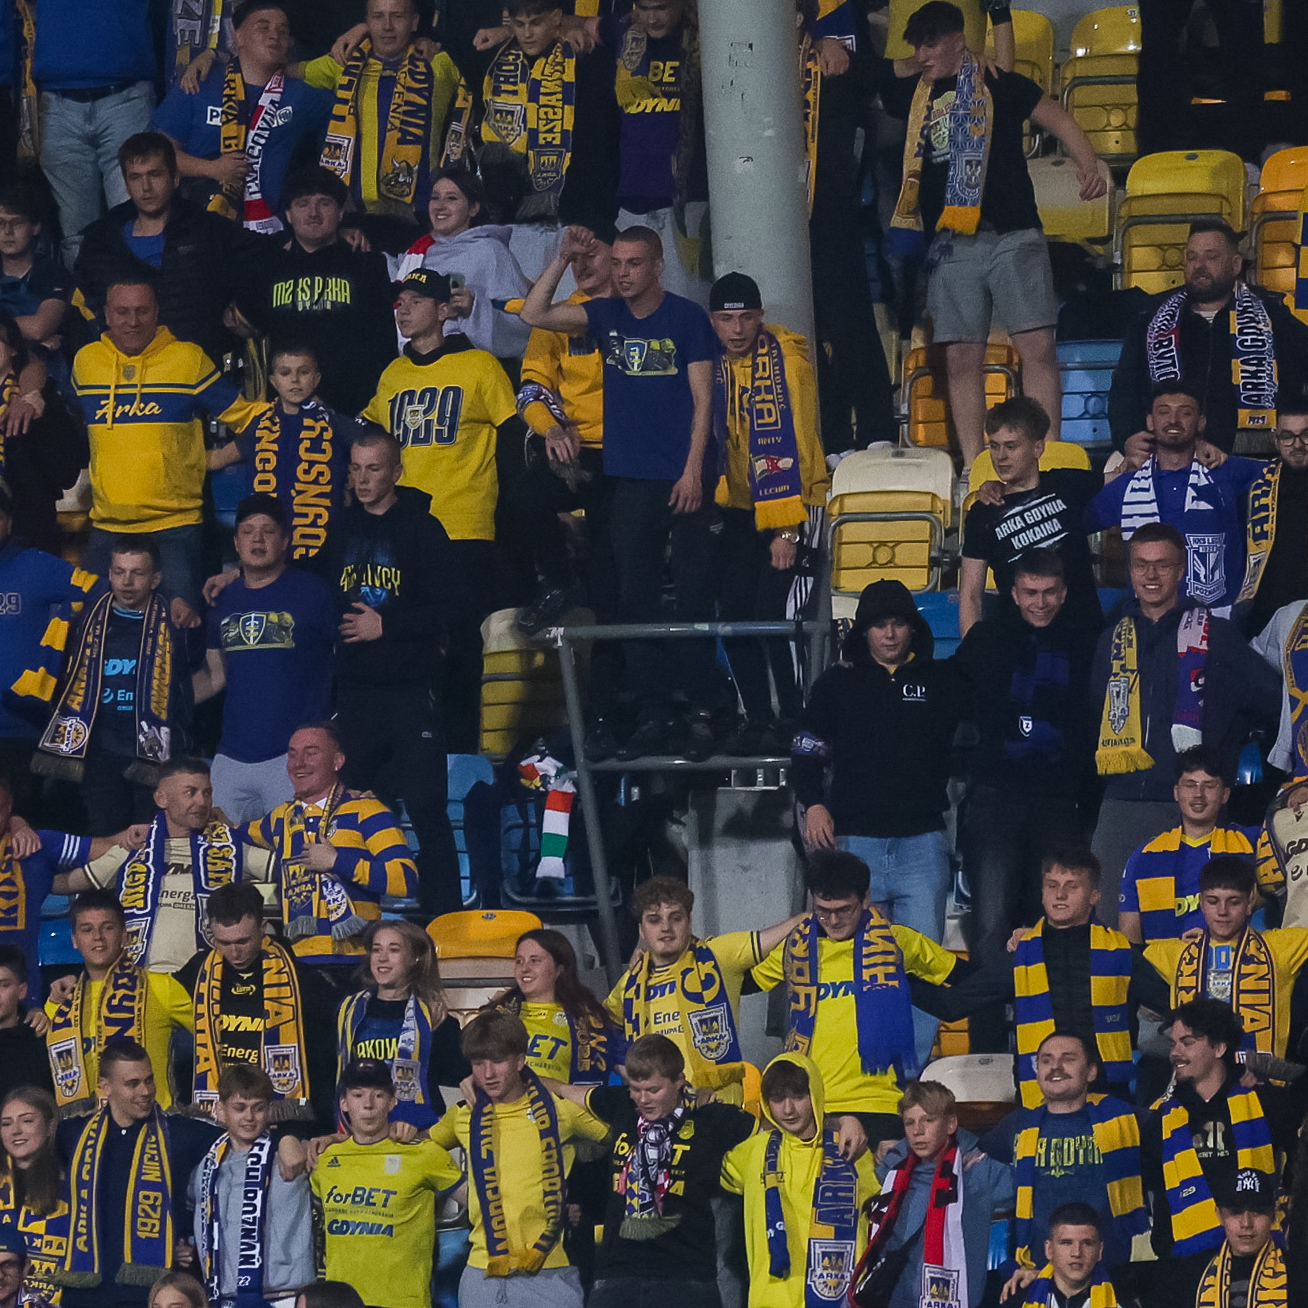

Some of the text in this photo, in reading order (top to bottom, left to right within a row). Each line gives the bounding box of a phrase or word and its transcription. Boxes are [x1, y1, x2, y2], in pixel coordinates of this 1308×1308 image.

[756, 330, 781, 431] ARKA
[1241, 358, 1265, 406] ARKA
[95, 398, 162, 420] Arka
[994, 500, 1067, 541] ARKA GDYNIA
[1011, 518, 1062, 551] KOKAINA
[63, 723, 73, 753] ARKA
[204, 845, 237, 889] SAM
[816, 980, 859, 1001] DYN
[219, 1016, 265, 1032] DYNI
[653, 1010, 680, 1024] Ene
[700, 1034, 729, 1044] ARKA
[220, 1046, 258, 1062] Energ
[272, 1070, 298, 1080] ARKA
[326, 1188, 397, 1209] forBET
[138, 1192, 162, 1238] 1929
[328, 1219, 394, 1237] GDYNIA
[814, 1273, 845, 1284] ARKA
